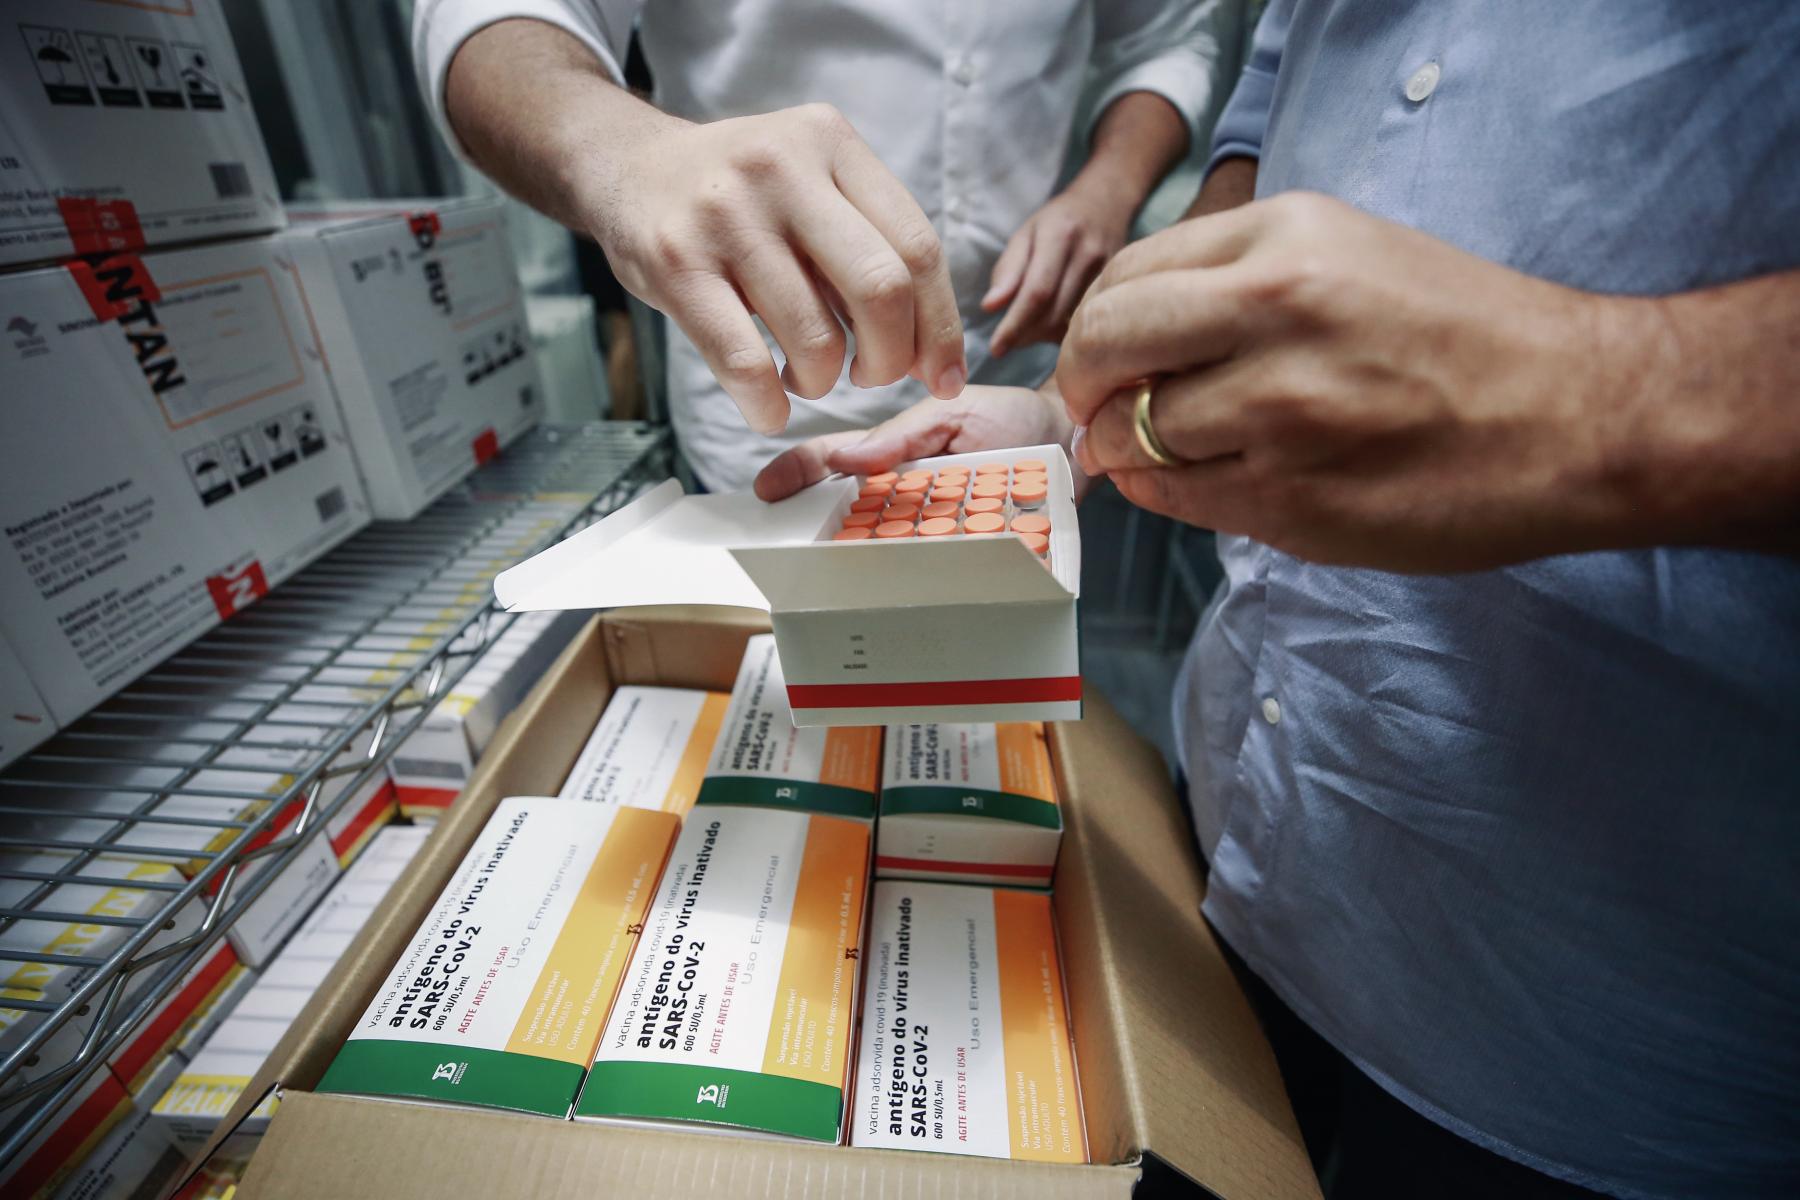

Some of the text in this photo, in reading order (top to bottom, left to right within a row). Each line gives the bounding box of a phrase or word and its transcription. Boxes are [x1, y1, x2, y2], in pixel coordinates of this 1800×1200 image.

[388, 811, 529, 1027] antígeno do vírus inativado
[505, 936, 531, 968] Uso
[636, 821, 721, 1048] antígeno do vírus inativado
[740, 854, 782, 985] Uso Emergencial
[367, 990, 397, 1028] vacina
[393, 937, 430, 989] adsorvida
[427, 897, 456, 936] covid-19
[409, 926, 481, 1029] SARS-CoV-2
[457, 945, 510, 1034] AGITE ANTES DE USAR
[615, 1009, 636, 1049] vacina
[630, 953, 655, 1007] adsorvida
[649, 910, 670, 952] covid-19
[659, 941, 705, 1049] SARS-CoV-2
[965, 917, 980, 1050] Uso Emergencial
[432, 975, 470, 1031] 600 SU/0,5mL
[534, 1031, 547, 1044] Via
[581, 1005, 592, 1016] 40
[682, 993, 707, 1052] 600 SU/0,5mL
[708, 962, 739, 1054] AGITE ANTES DE USAR
[825, 1024, 835, 1037] 40
[875, 991, 886, 1034] covid-19
[887, 896, 912, 1135] antígeno do vírus inativado
[788, 1051, 799, 1065] Via
[870, 1036, 883, 1092] adsorvida
[910, 1025, 928, 1137] SARS-CoV-2
[956, 1046, 967, 1141] AGITE ANTES DE USAR
[868, 1094, 880, 1135] vacina
[933, 1079, 944, 1139] 600 SU/0,5mL
[1032, 1135, 1041, 1149] Via
[1057, 1105, 1067, 1118] 40
